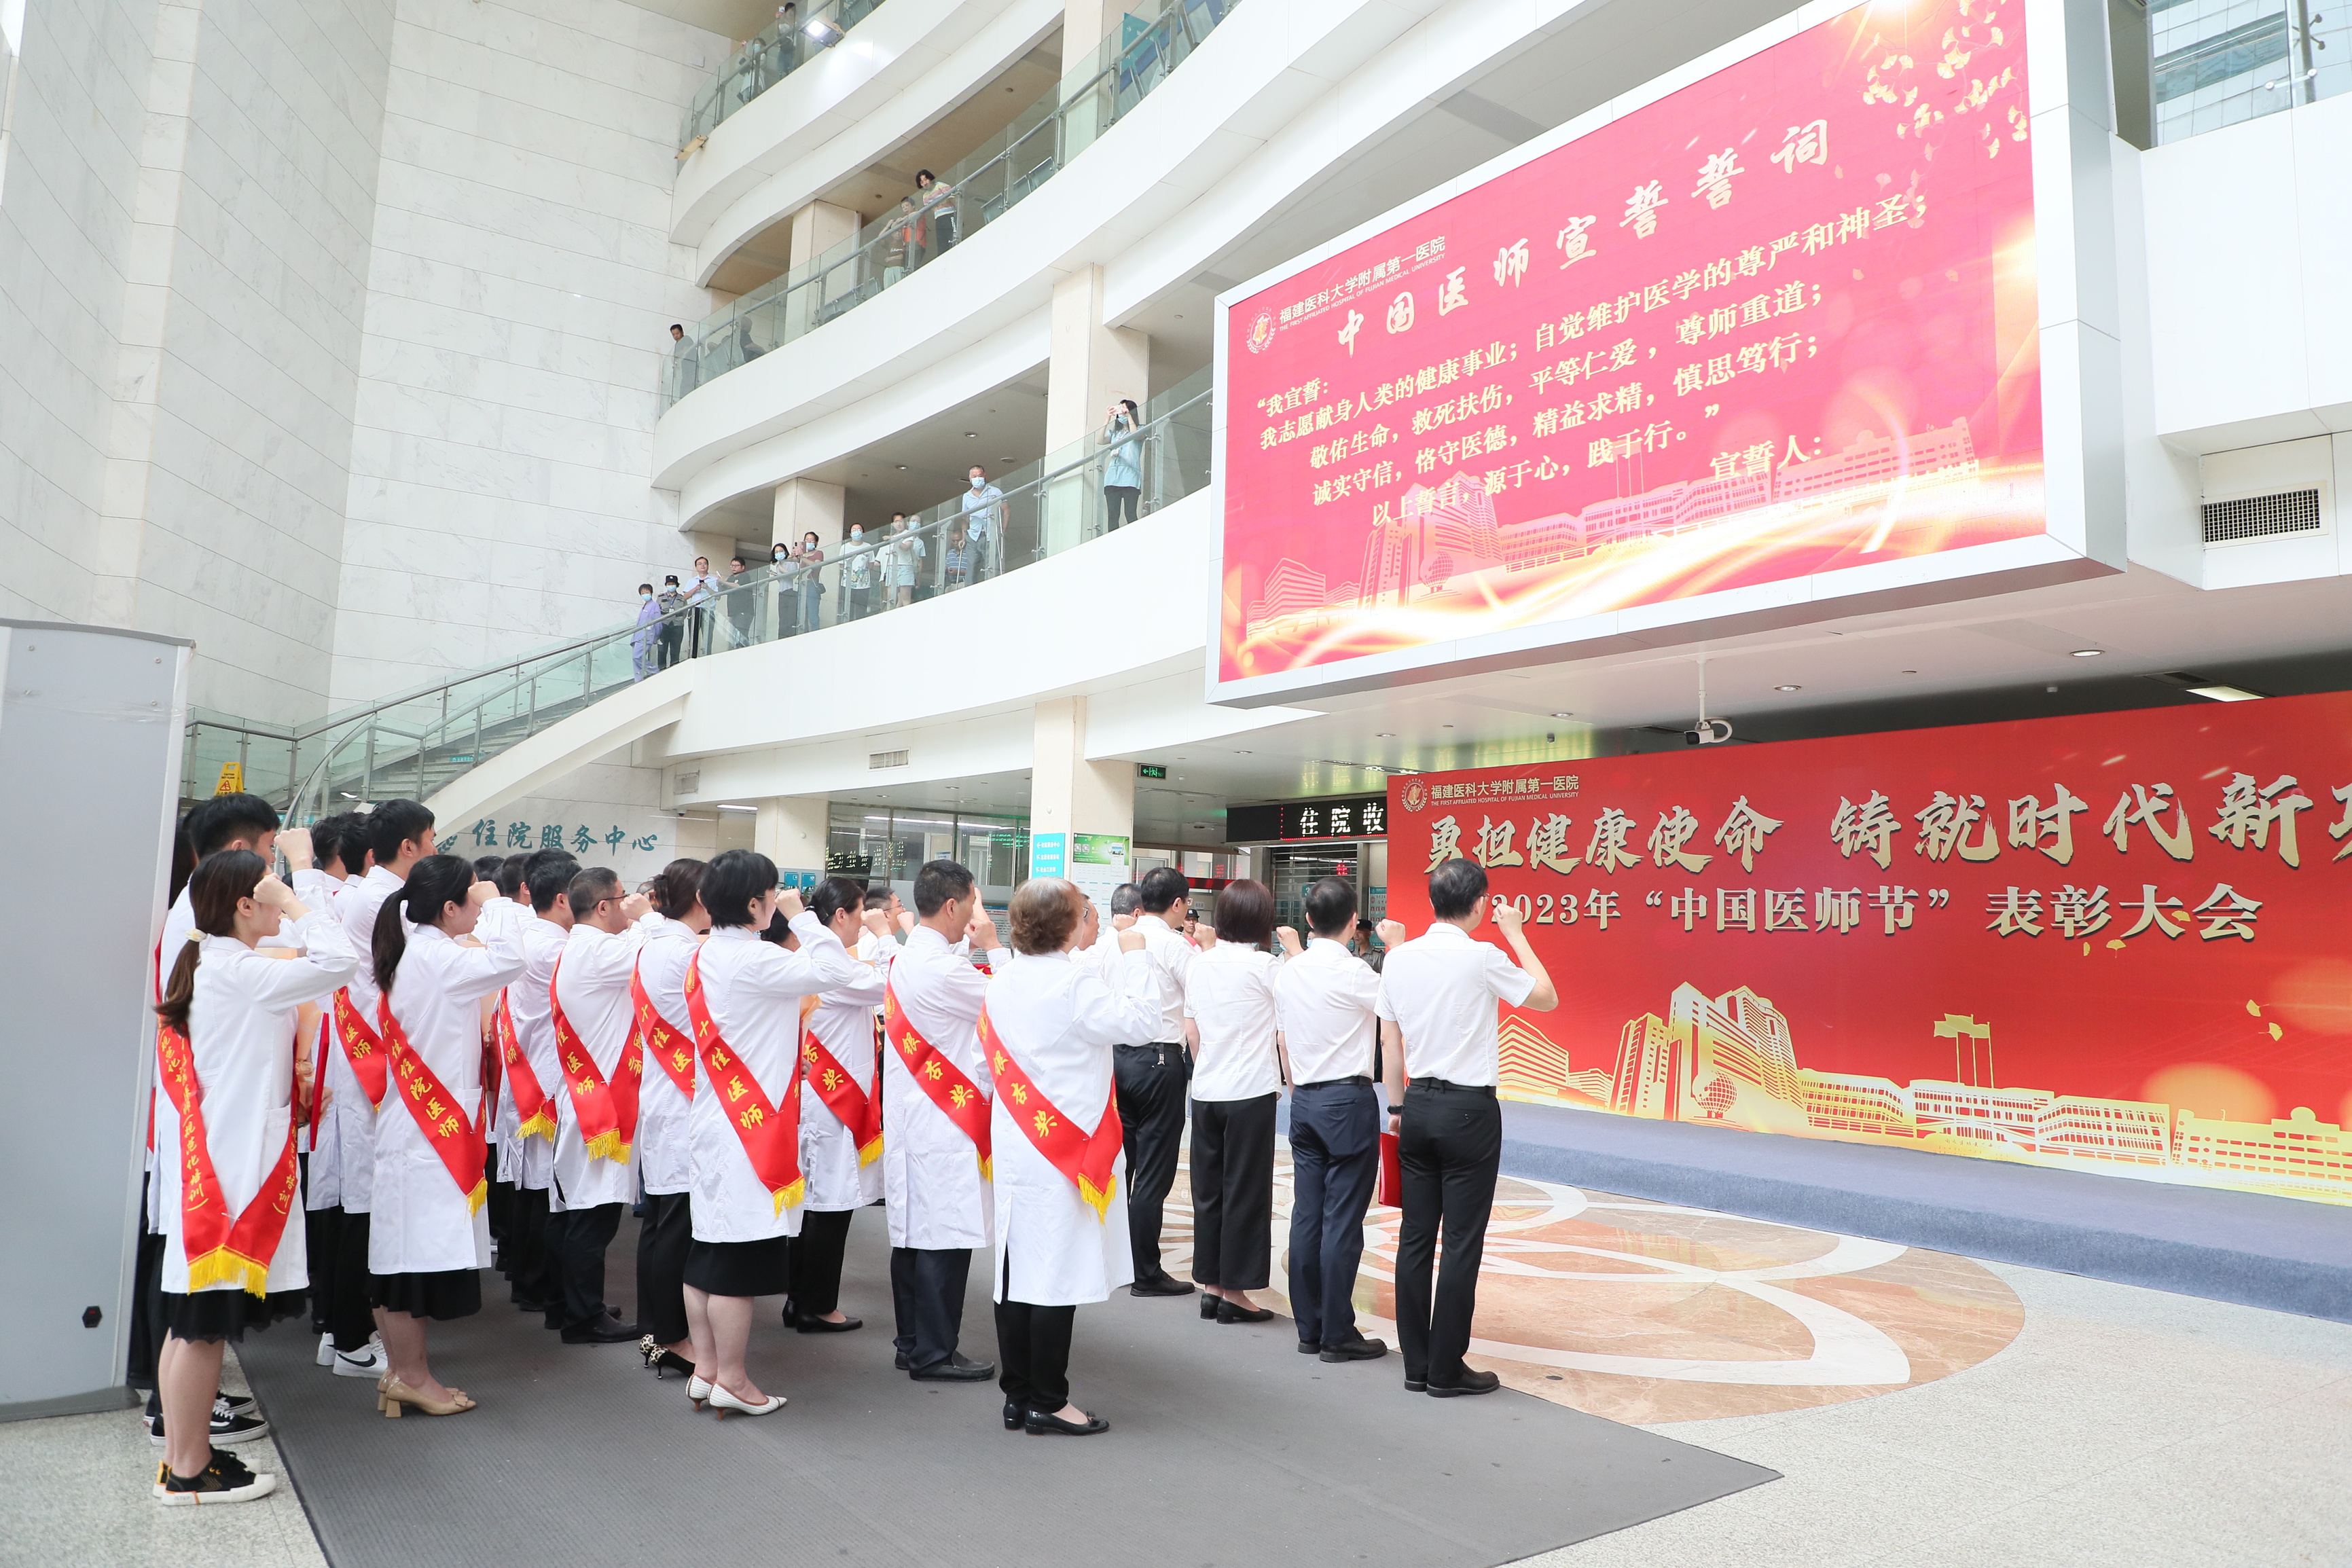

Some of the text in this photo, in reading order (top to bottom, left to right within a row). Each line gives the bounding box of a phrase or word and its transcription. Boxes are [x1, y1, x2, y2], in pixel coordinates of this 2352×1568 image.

[1337, 119, 1828, 359] 中国医师宣誓誓词
[1279, 236, 1445, 325] 福建医科大学附属第一医院
[1290, 316, 1303, 327] FIRST
[1303, 306, 1330, 322] AFFILIATED
[1331, 293, 1356, 308] HOSPITAL
[1365, 281, 1384, 293] FUJIAN
[1386, 270, 1409, 283] MEDICAL
[1411, 253, 1445, 272] UNIVERSITY
[1299, 802, 1384, 837] 住院收
[1424, 771, 2352, 875] 勇担健康使命 铸就时代新
[1431, 774, 1578, 799] 福建医科大学附属第一医院
[473, 819, 657, 856] 住院服务中心
[698, 1020, 765, 1130] 十佳医师
